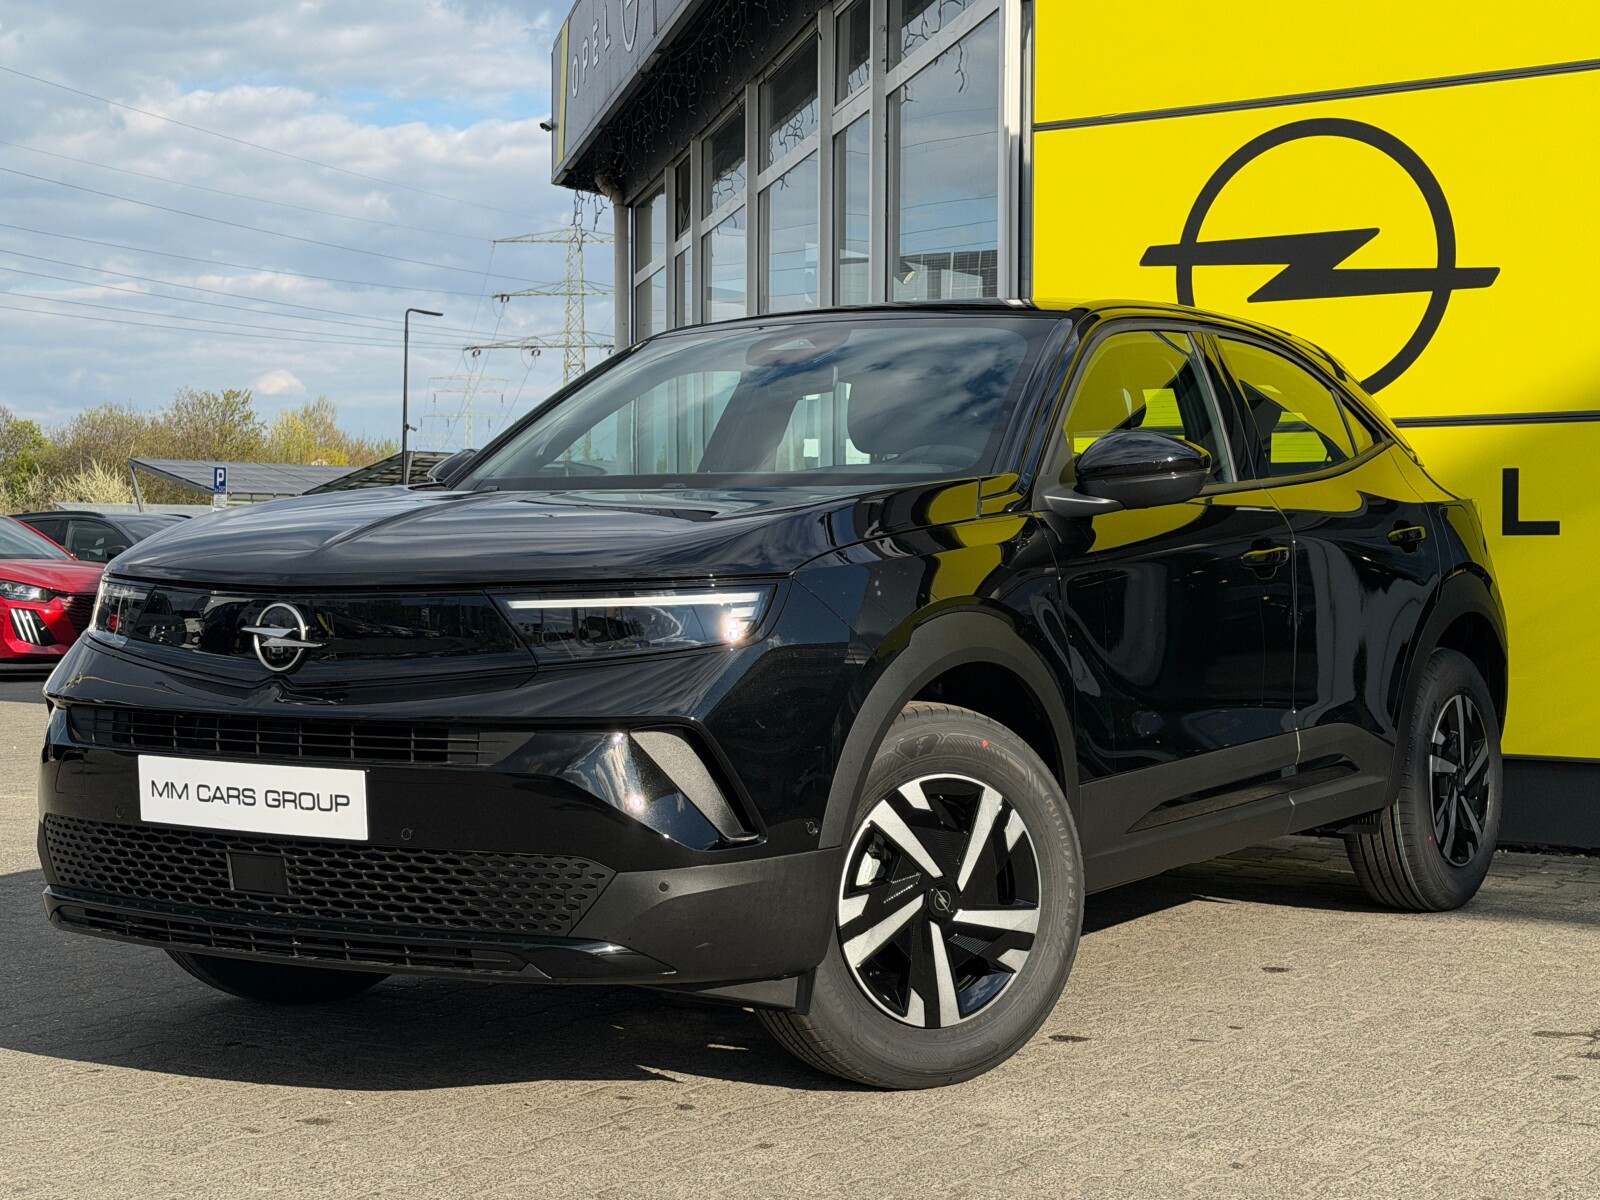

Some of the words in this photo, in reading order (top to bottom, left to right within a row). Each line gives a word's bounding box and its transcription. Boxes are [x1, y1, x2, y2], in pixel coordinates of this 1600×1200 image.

[572, 4, 611, 99] OPEL
[216, 468, 225, 486] P
[151, 779, 189, 801] MM
[196, 784, 257, 807] CARS
[264, 789, 351, 813] GROUP
